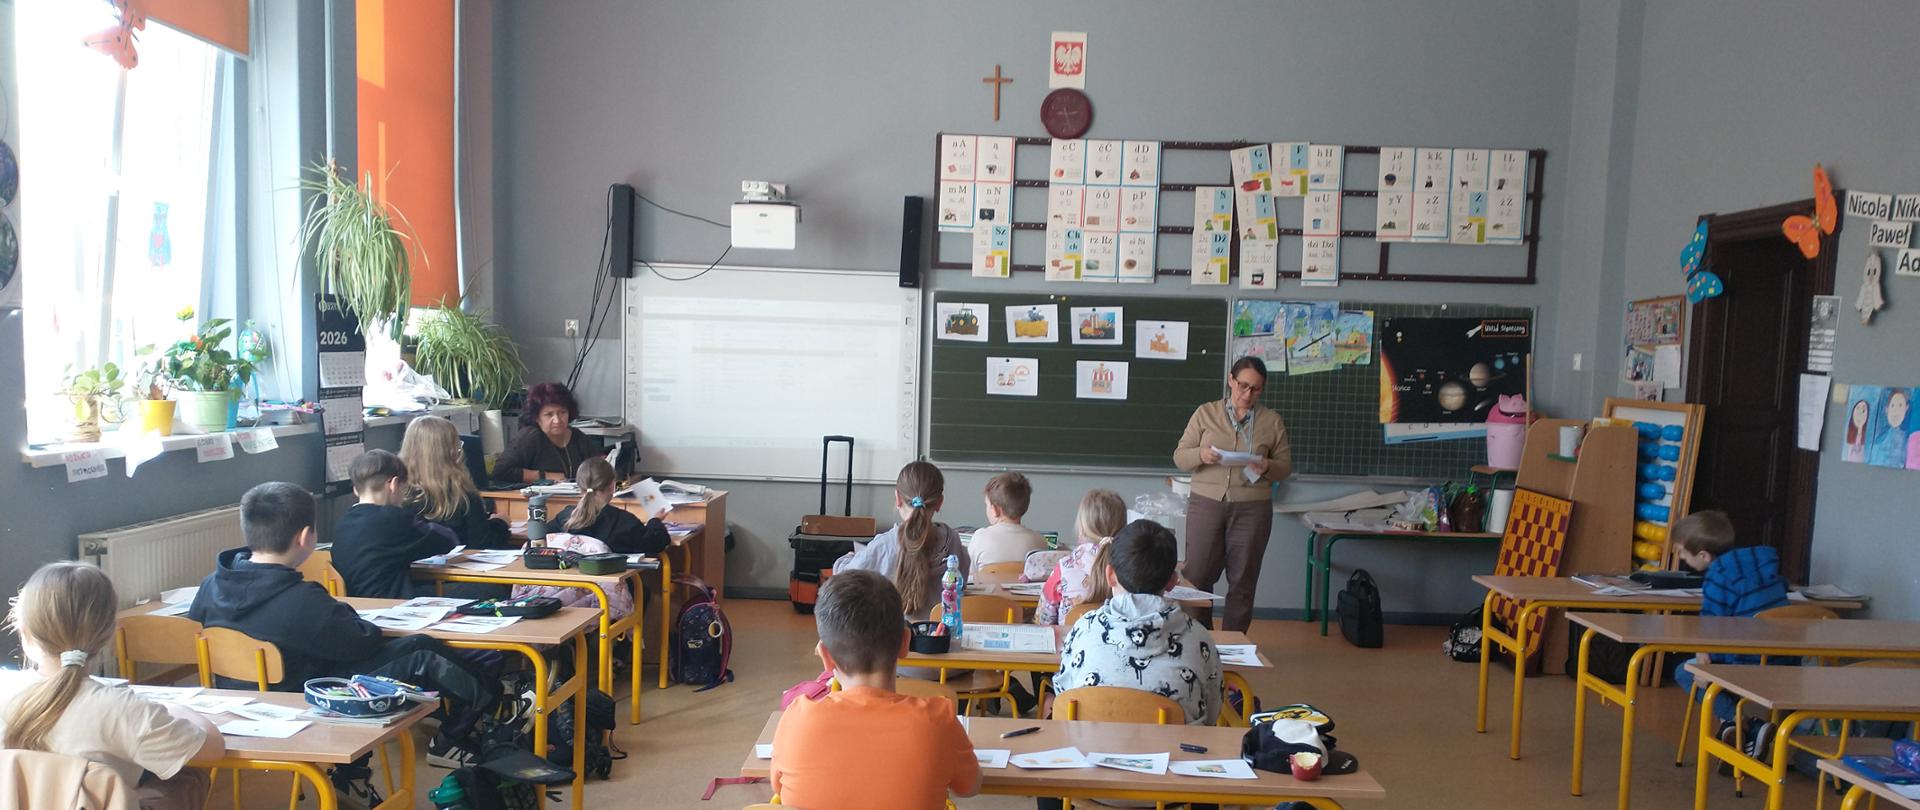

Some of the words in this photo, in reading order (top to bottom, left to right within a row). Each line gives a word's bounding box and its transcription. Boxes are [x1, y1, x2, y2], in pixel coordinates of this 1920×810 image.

[1848, 194, 1887, 218] Nicola
[1896, 197, 1920, 218] Nik
[1067, 230, 1080, 239] Ch
[1871, 224, 1909, 244] Paweł
[320, 331, 347, 345] 2026
